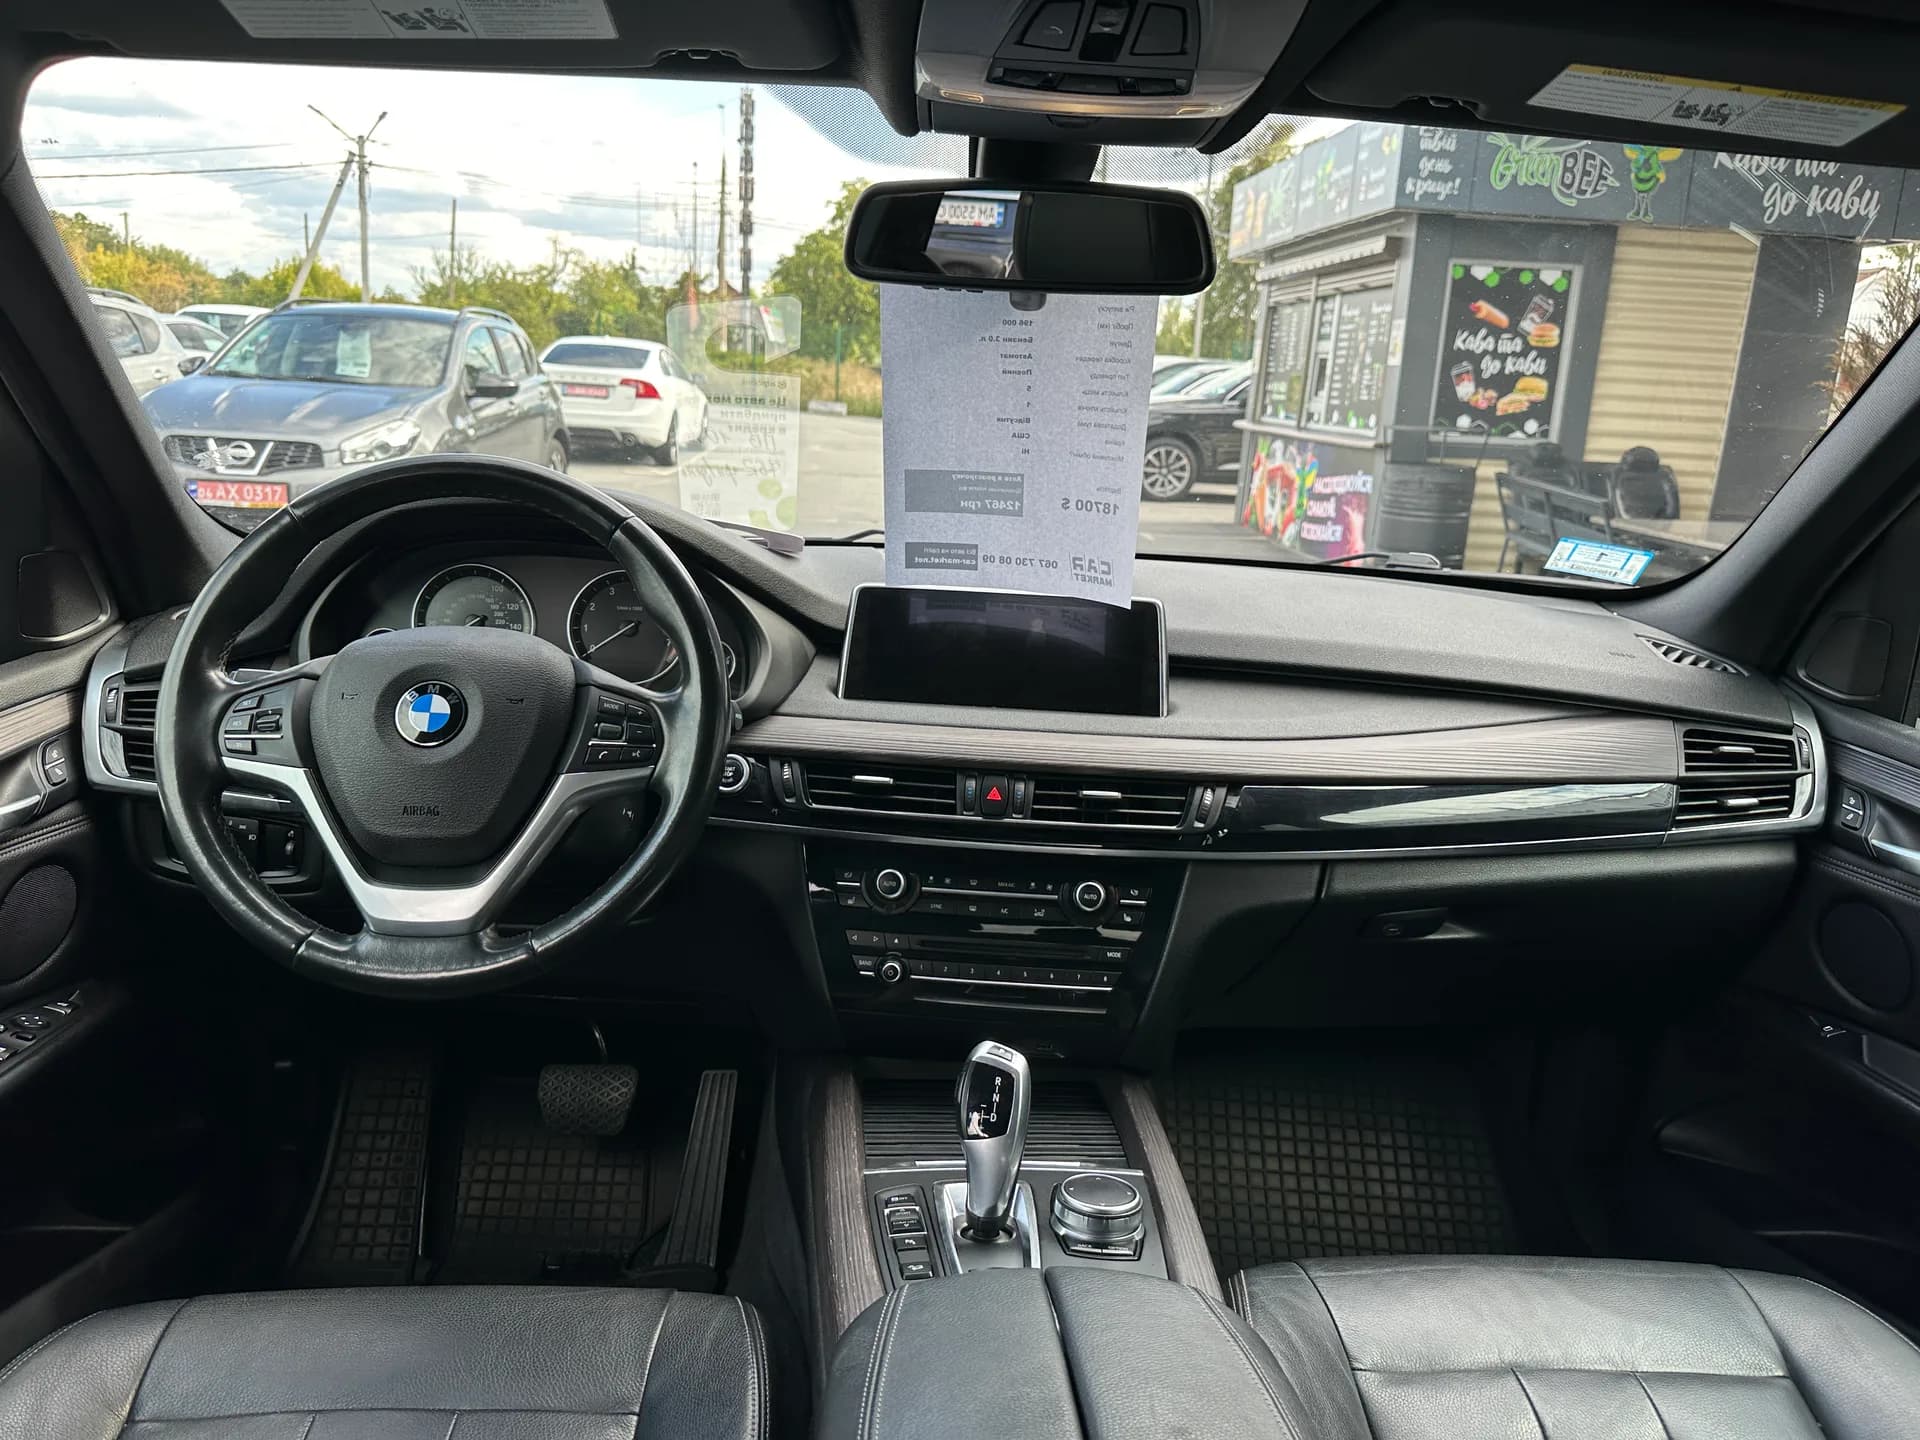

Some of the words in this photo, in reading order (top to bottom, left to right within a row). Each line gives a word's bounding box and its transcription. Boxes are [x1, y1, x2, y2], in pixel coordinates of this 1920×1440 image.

[1763, 182, 1799, 225] до
[1806, 174, 1881, 220] кави
[1454, 327, 1495, 354] Кава
[1504, 350, 1548, 375] кави
[216, 484, 240, 500] AX
[507, 603, 520, 611] 120
[589, 603, 596, 611] 2
[510, 623, 522, 631] 140
[666, 638, 672, 647] 7
[406, 684, 460, 704] BMW
[402, 806, 440, 816] AIRBAG
[1084, 893, 1098, 901] AUTO
[995, 1076, 1002, 1086] R
[992, 1093, 1000, 1103] N
[990, 1112, 997, 1122] D
